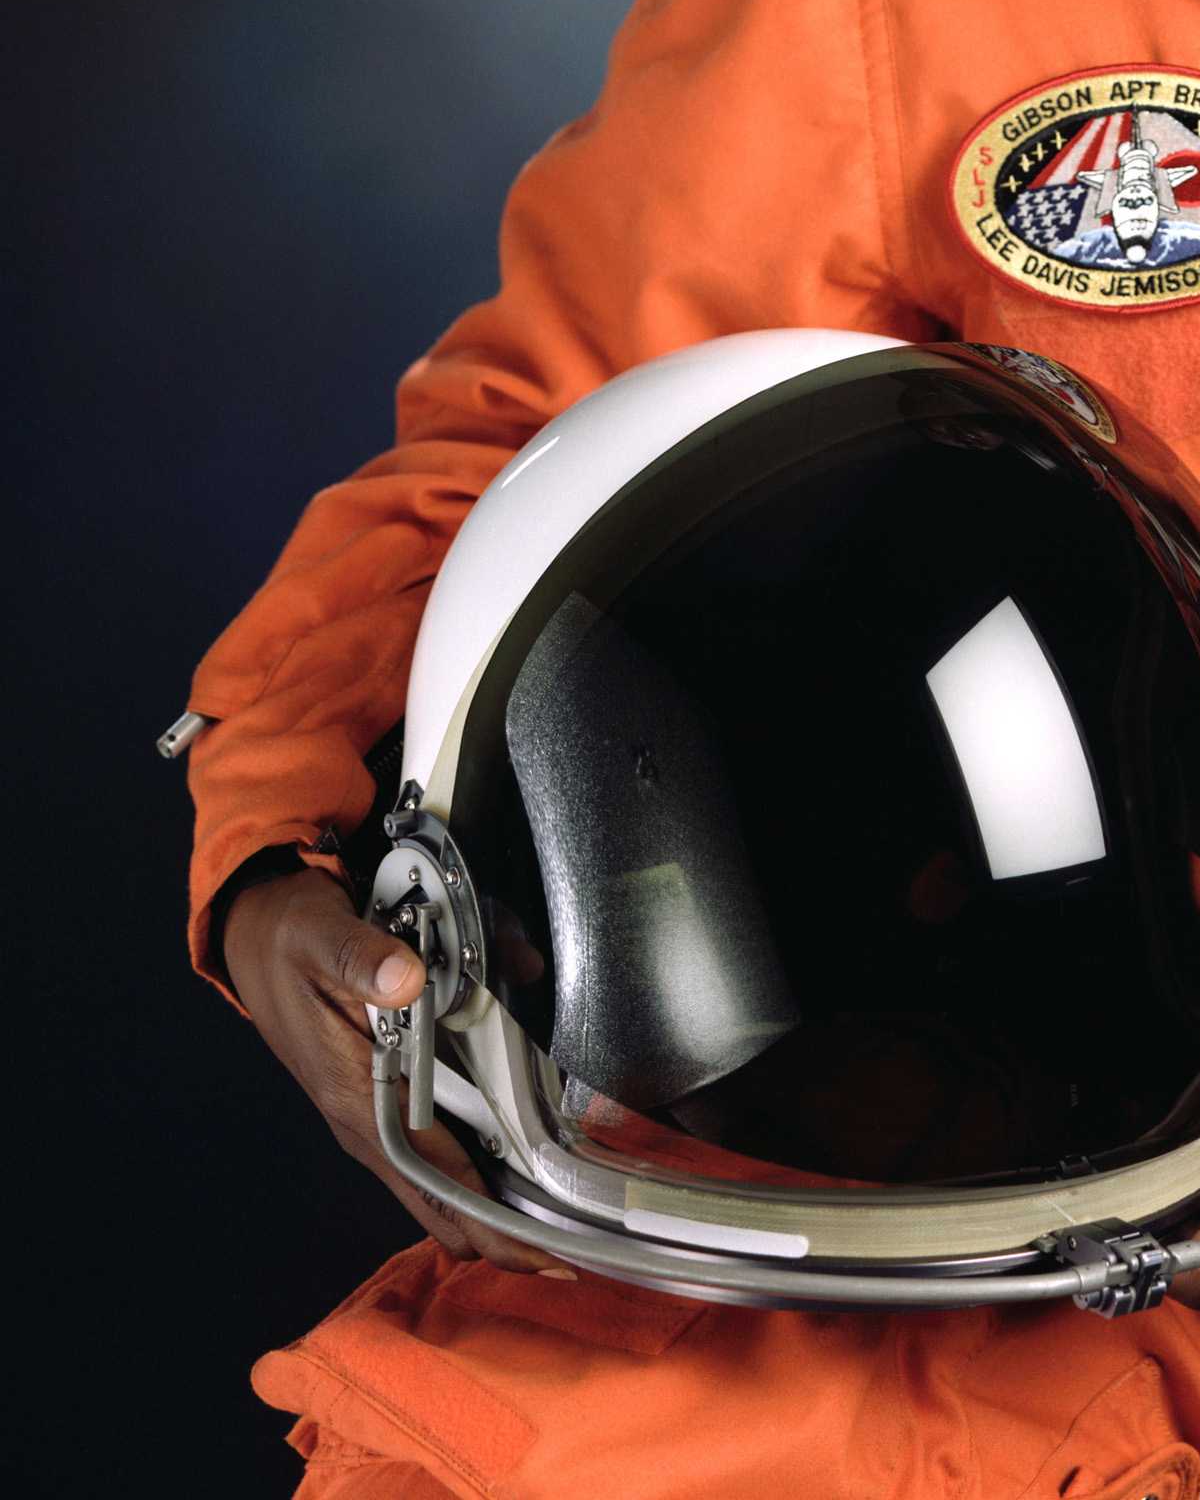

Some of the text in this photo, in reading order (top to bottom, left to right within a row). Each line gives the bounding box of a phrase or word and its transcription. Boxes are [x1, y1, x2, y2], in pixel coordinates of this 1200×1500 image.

[1002, 86, 1093, 143] GIBSON
[1110, 80, 1162, 101] APT
[976, 214, 1019, 262] LEE
[1022, 254, 1092, 294] DAVIS
